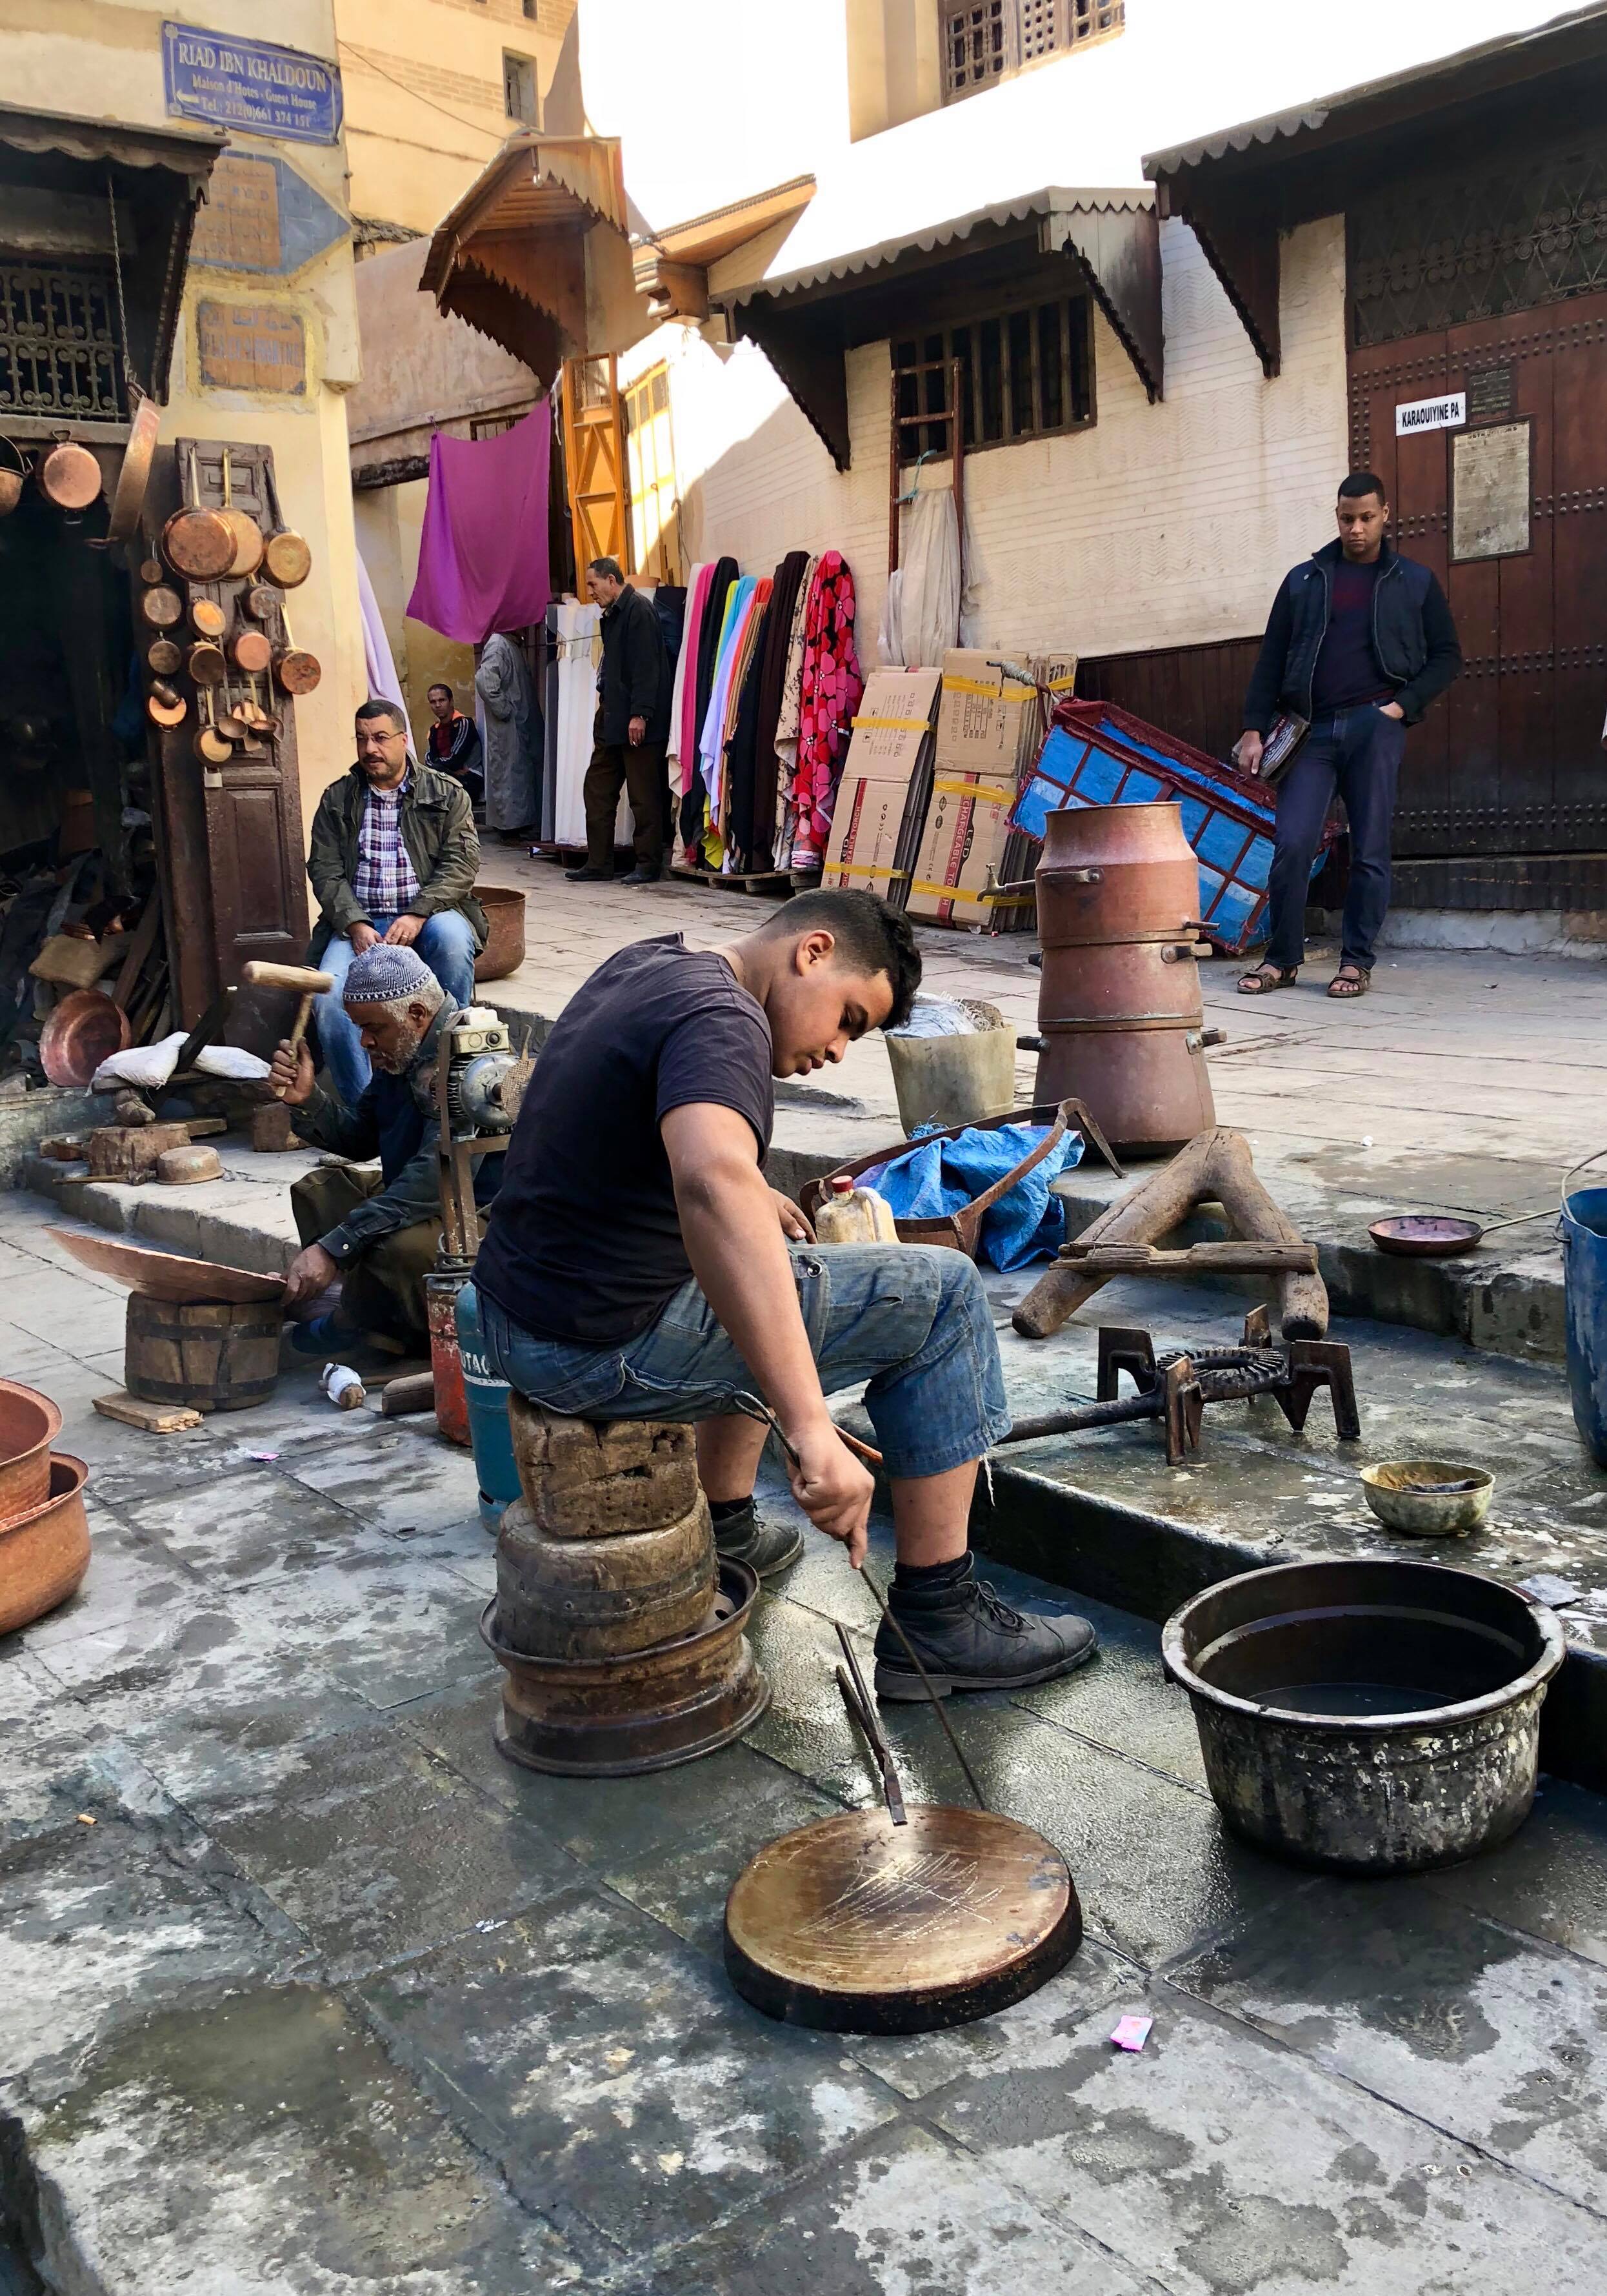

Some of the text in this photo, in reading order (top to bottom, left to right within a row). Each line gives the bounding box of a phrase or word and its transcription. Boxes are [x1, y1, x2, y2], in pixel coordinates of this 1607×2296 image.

[179, 42, 326, 93] RIAD IBN KHALDOUN
[192, 73, 225, 92] Maison
[265, 88, 290, 105] Guest
[290, 93, 317, 110] House
[275, 110, 292, 125] 374
[295, 113, 310, 128] 151
[1402, 401, 1459, 428] KARAOUIYINE PA
[942, 794, 972, 906] ECHARGEABLE TOH
[962, 829, 973, 858] LED
